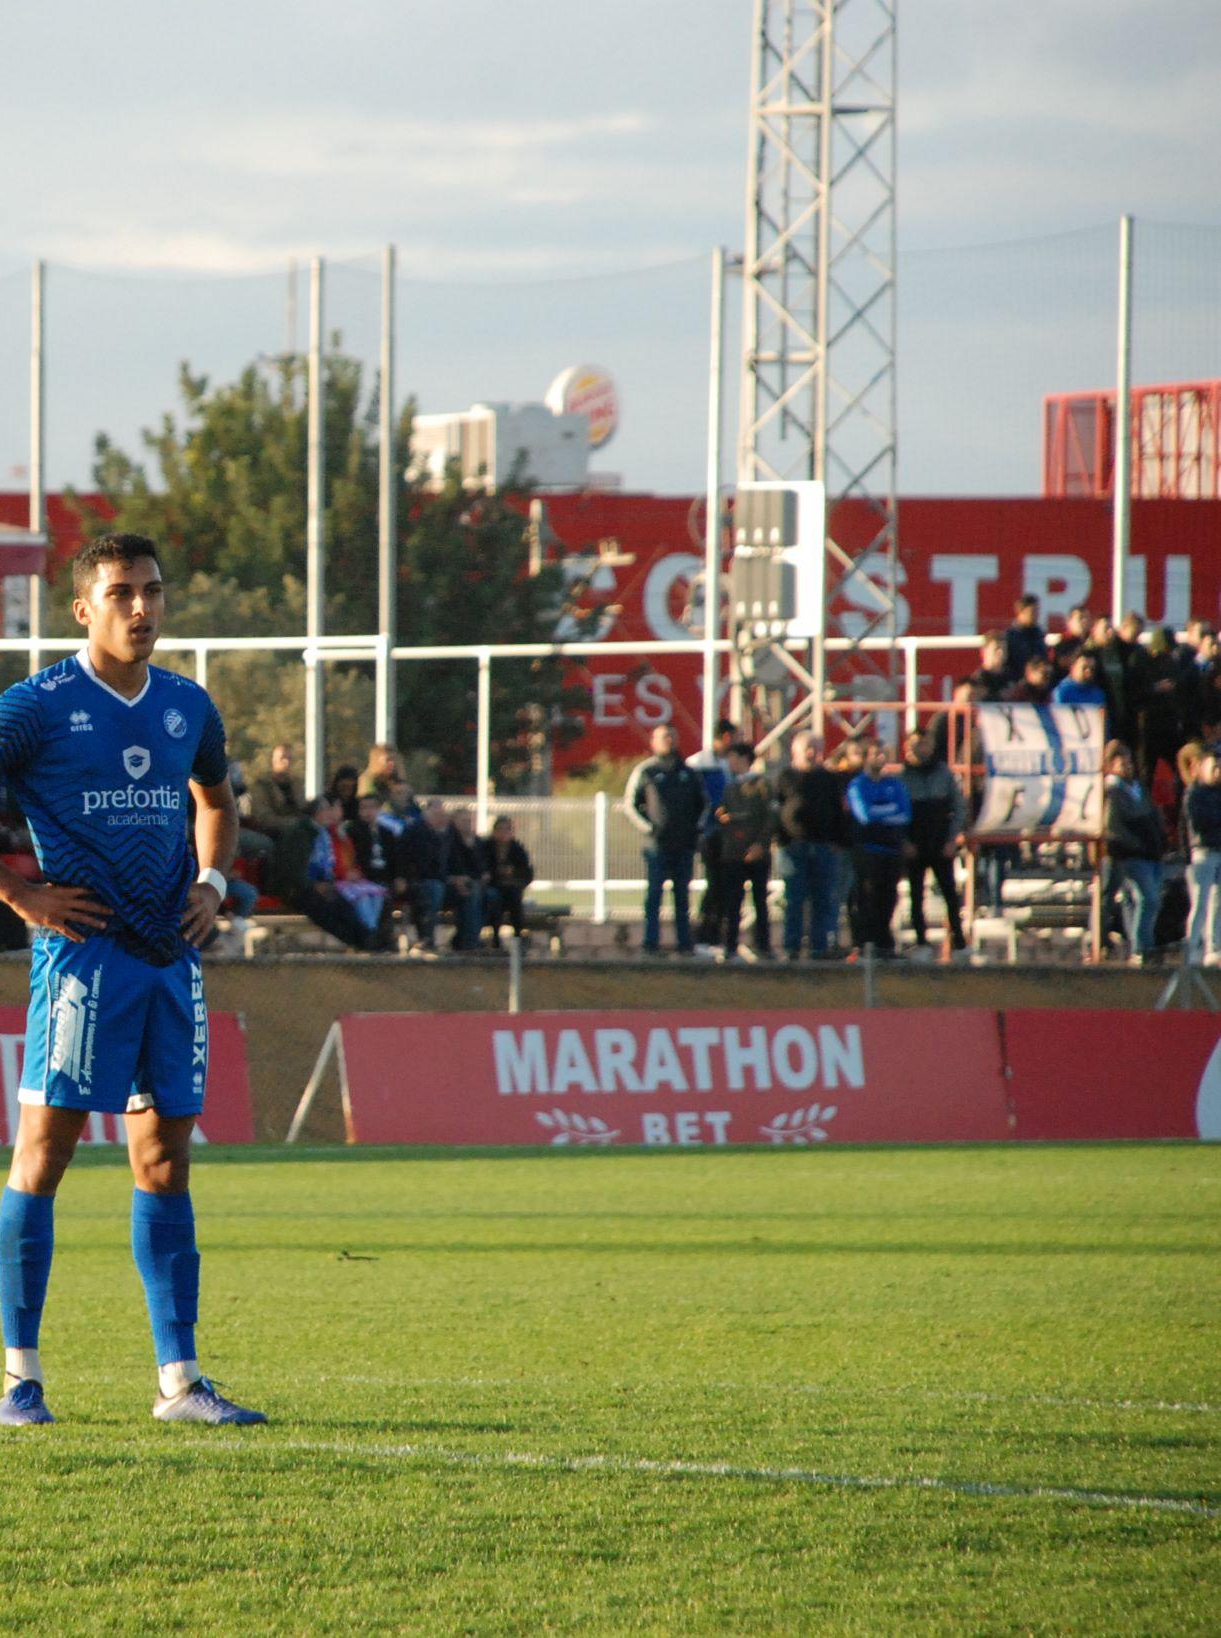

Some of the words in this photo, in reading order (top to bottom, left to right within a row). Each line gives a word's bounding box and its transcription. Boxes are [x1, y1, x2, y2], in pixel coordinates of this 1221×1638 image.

[82, 784, 180, 814] prefortia
[107, 813, 169, 826] academia
[191, 962, 206, 1067] XEREZ
[492, 1024, 866, 1096] MARATHON
[642, 1110, 732, 1146] BET
